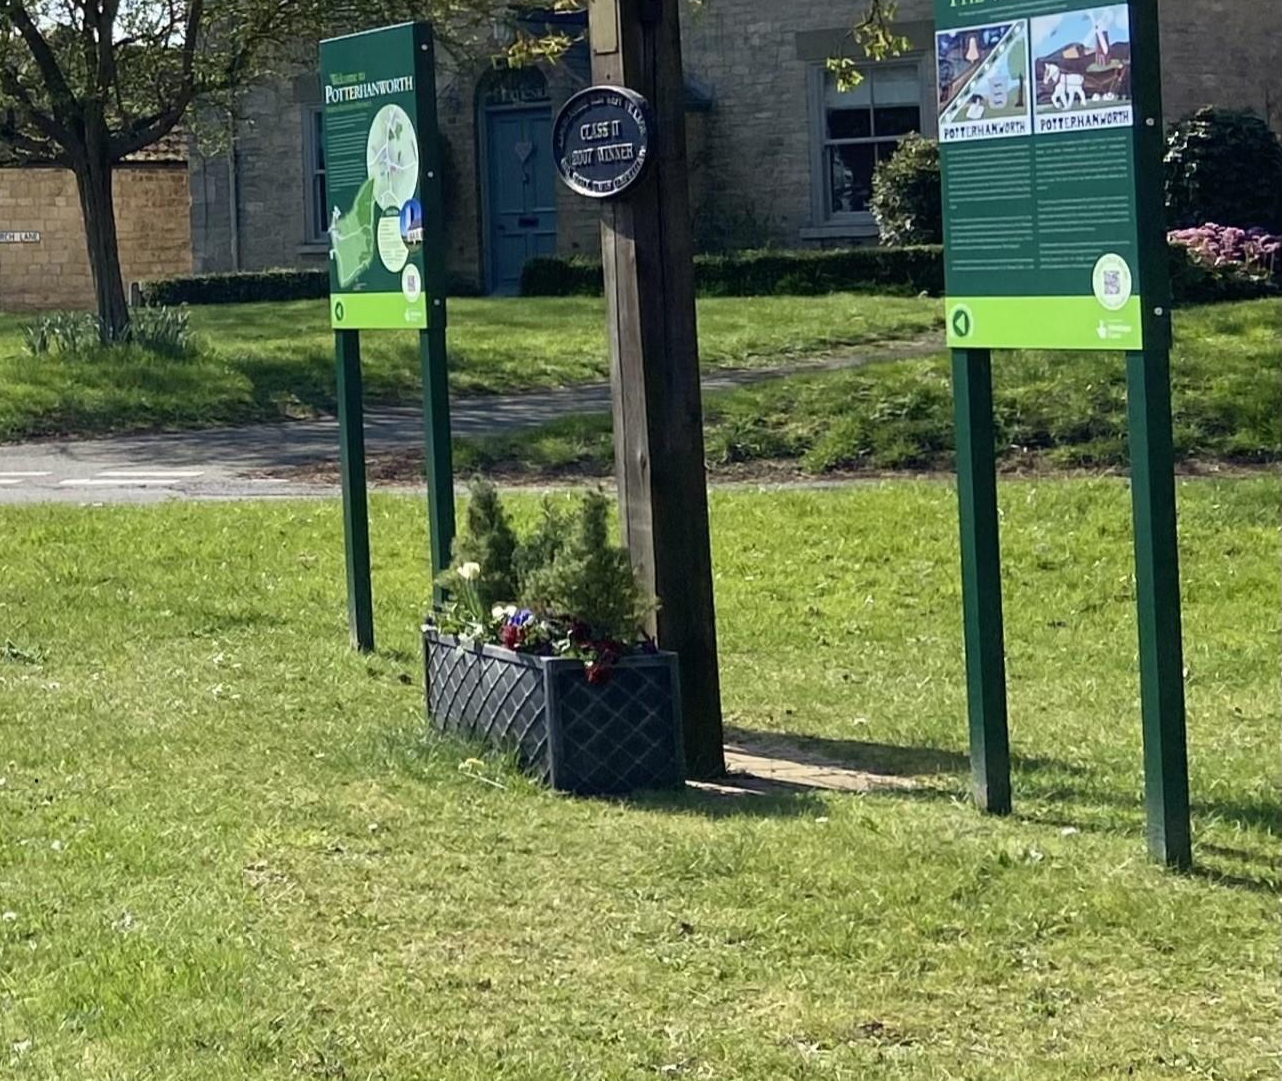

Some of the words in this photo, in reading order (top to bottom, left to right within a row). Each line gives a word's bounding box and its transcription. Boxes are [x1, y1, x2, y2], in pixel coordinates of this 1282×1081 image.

[325, 75, 414, 105] POTTERHANWORTH
[580, 121, 609, 140] CLASS
[944, 120, 1026, 140] POTTERHANWORTH
[1040, 109, 1129, 132] POTTERHANWORTH
[571, 147, 594, 166] 2007
[596, 142, 634, 163] WINNER
[20, 232, 38, 243] LANE
